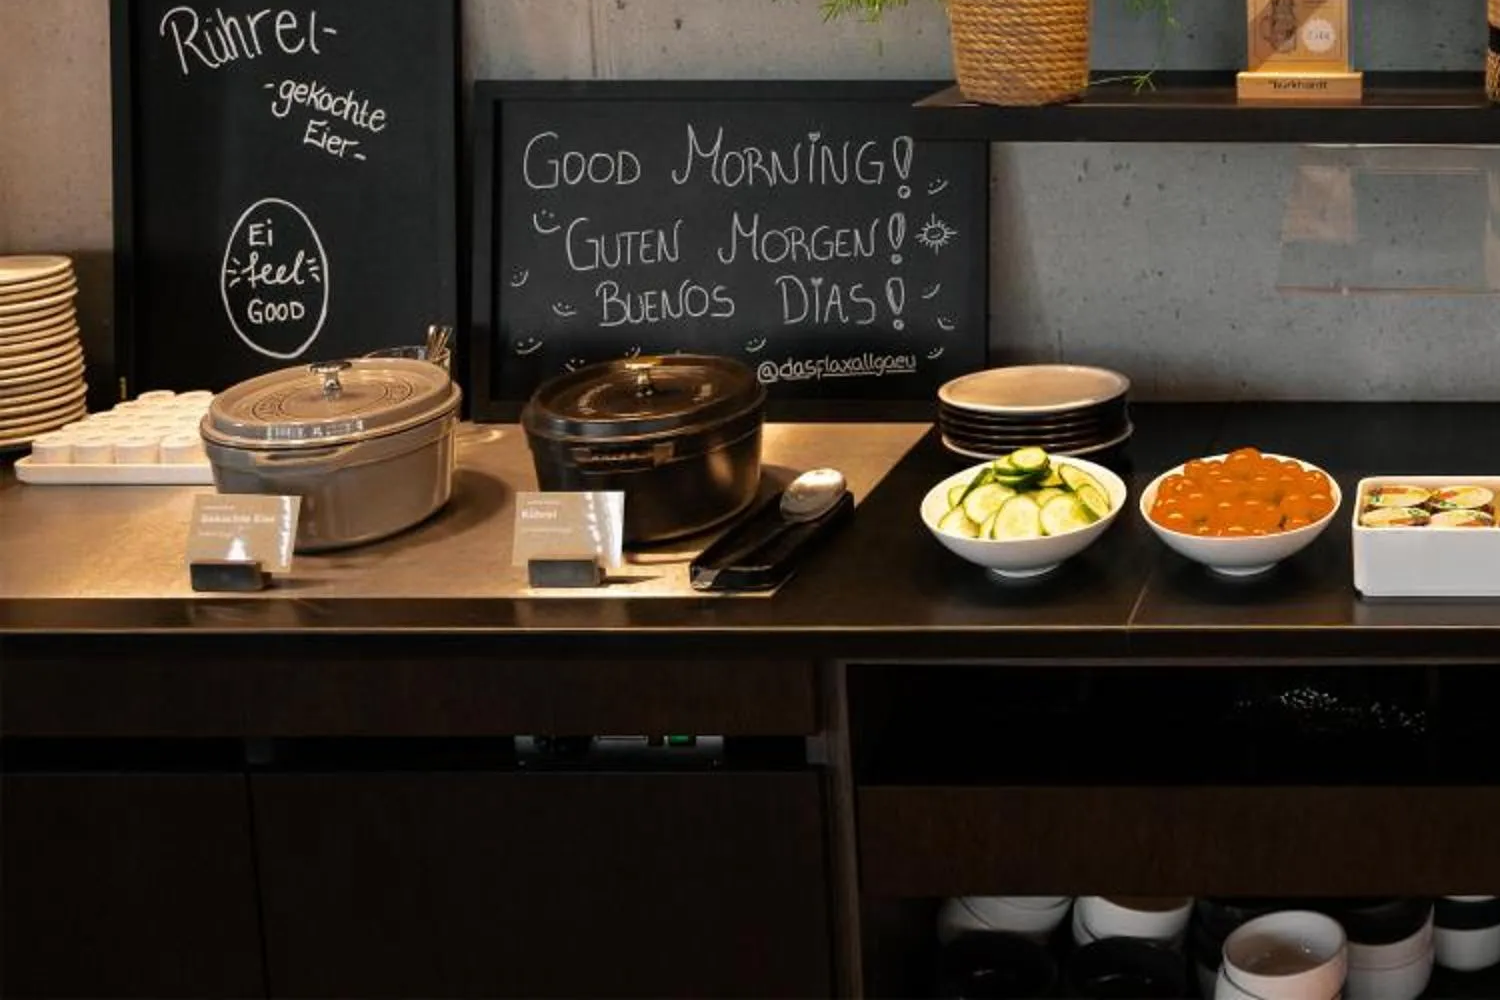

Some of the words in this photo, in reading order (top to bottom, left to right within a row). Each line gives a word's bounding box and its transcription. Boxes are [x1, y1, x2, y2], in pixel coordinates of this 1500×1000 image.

[522, 130, 641, 190] GOOD
[248, 218, 273, 247] Ei
[565, 216, 683, 272] GUTEN
[243, 249, 306, 288] feel
[247, 298, 305, 324] GOOD
[594, 278, 736, 327] BUENOS
